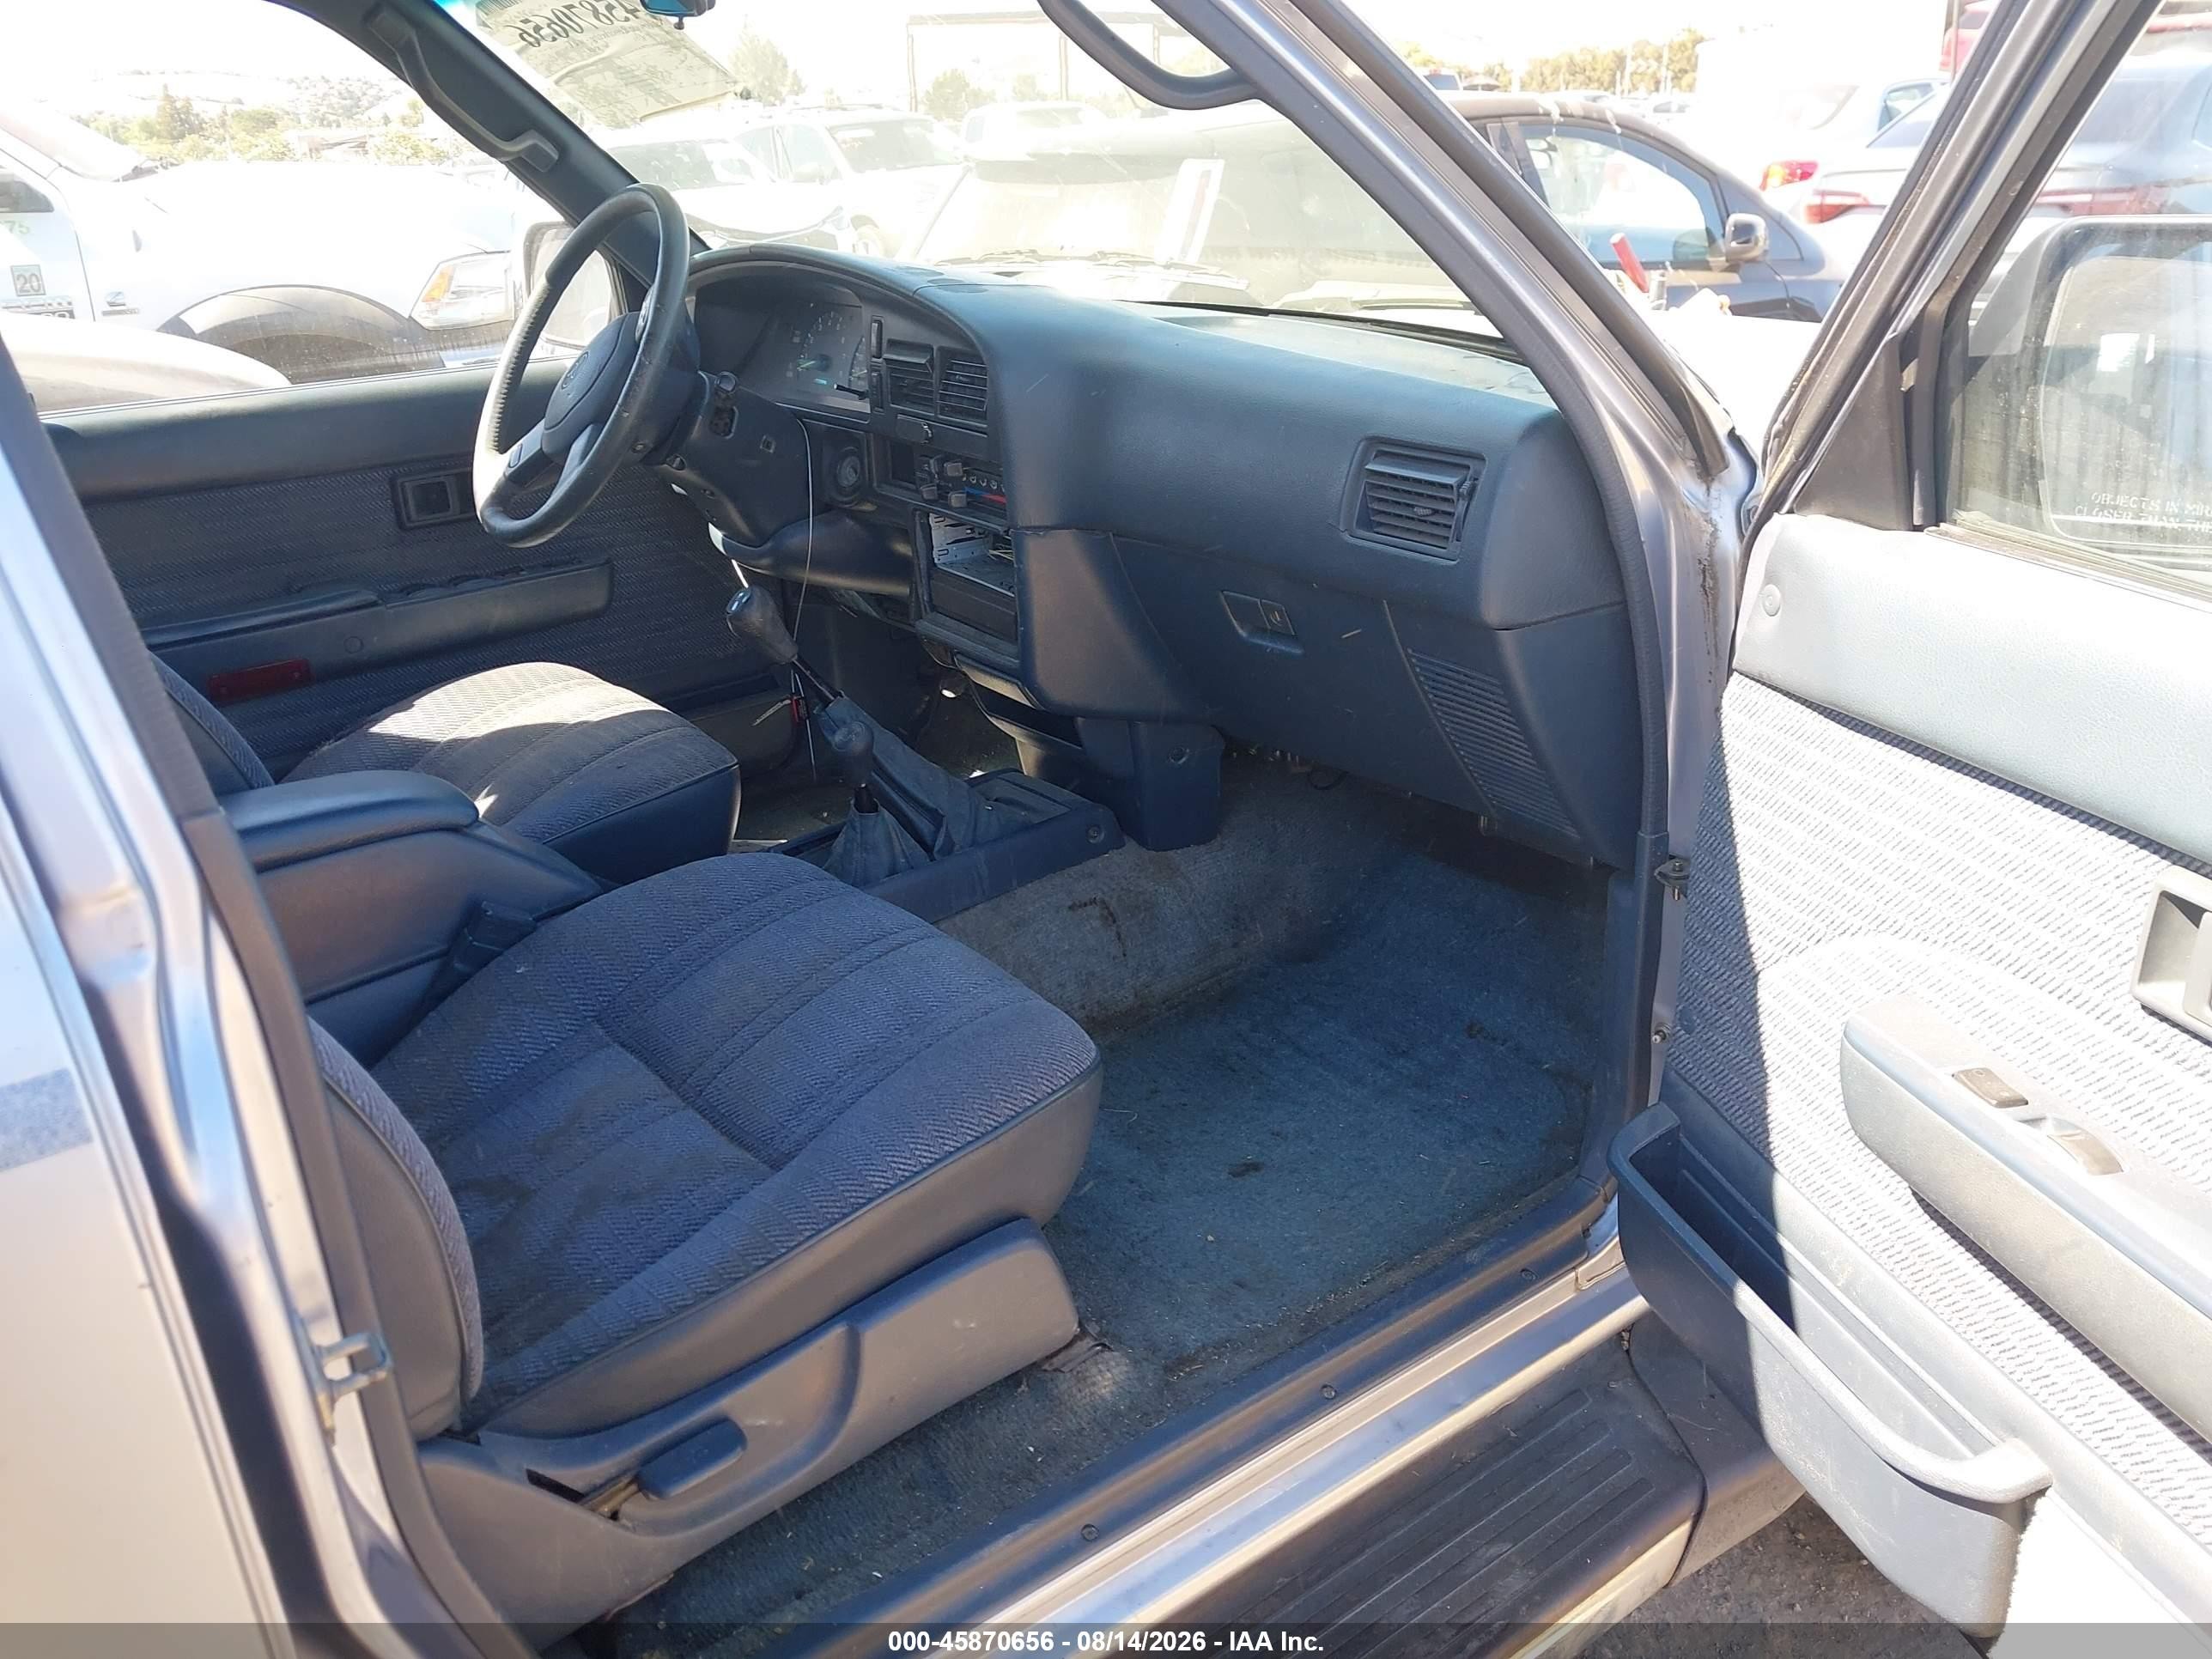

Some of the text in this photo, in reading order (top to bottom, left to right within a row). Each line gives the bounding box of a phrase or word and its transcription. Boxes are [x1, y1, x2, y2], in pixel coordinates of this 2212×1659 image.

[16, 273, 41, 293] 20
[2091, 492, 2160, 512] OBJECTS
[2075, 505, 2132, 520] CLOSER
